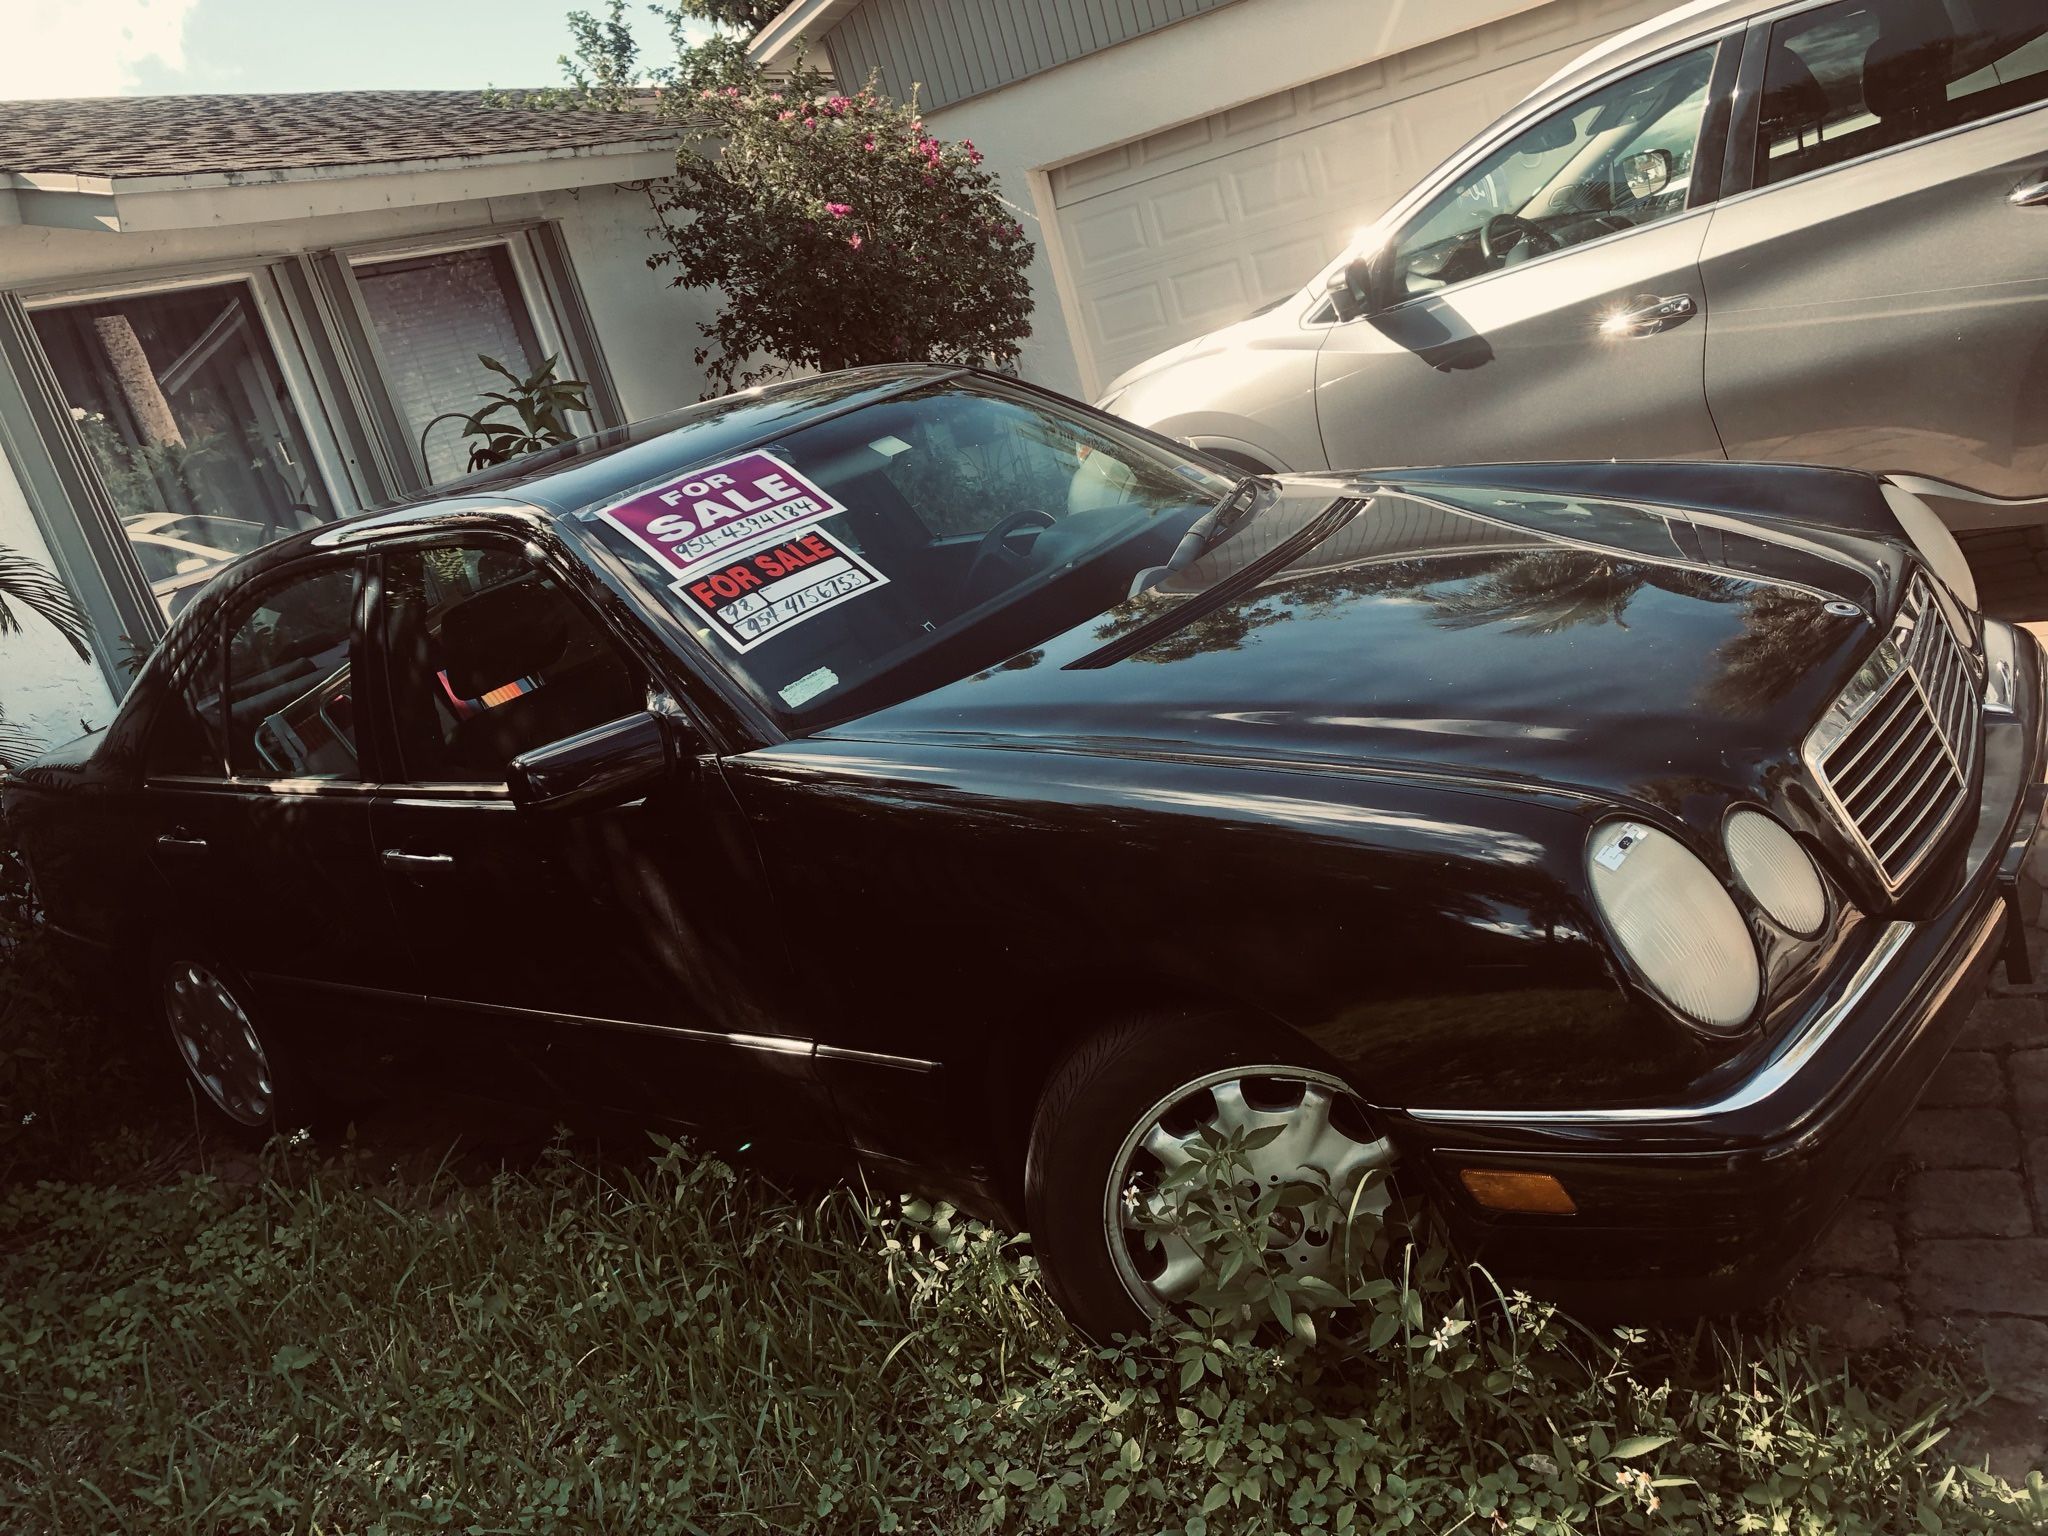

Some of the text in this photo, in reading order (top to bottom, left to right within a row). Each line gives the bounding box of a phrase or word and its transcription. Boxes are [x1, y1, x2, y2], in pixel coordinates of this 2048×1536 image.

[646, 473, 801, 542] SALE
[659, 473, 736, 507] FOR
[690, 535, 834, 608] FOR SALE
